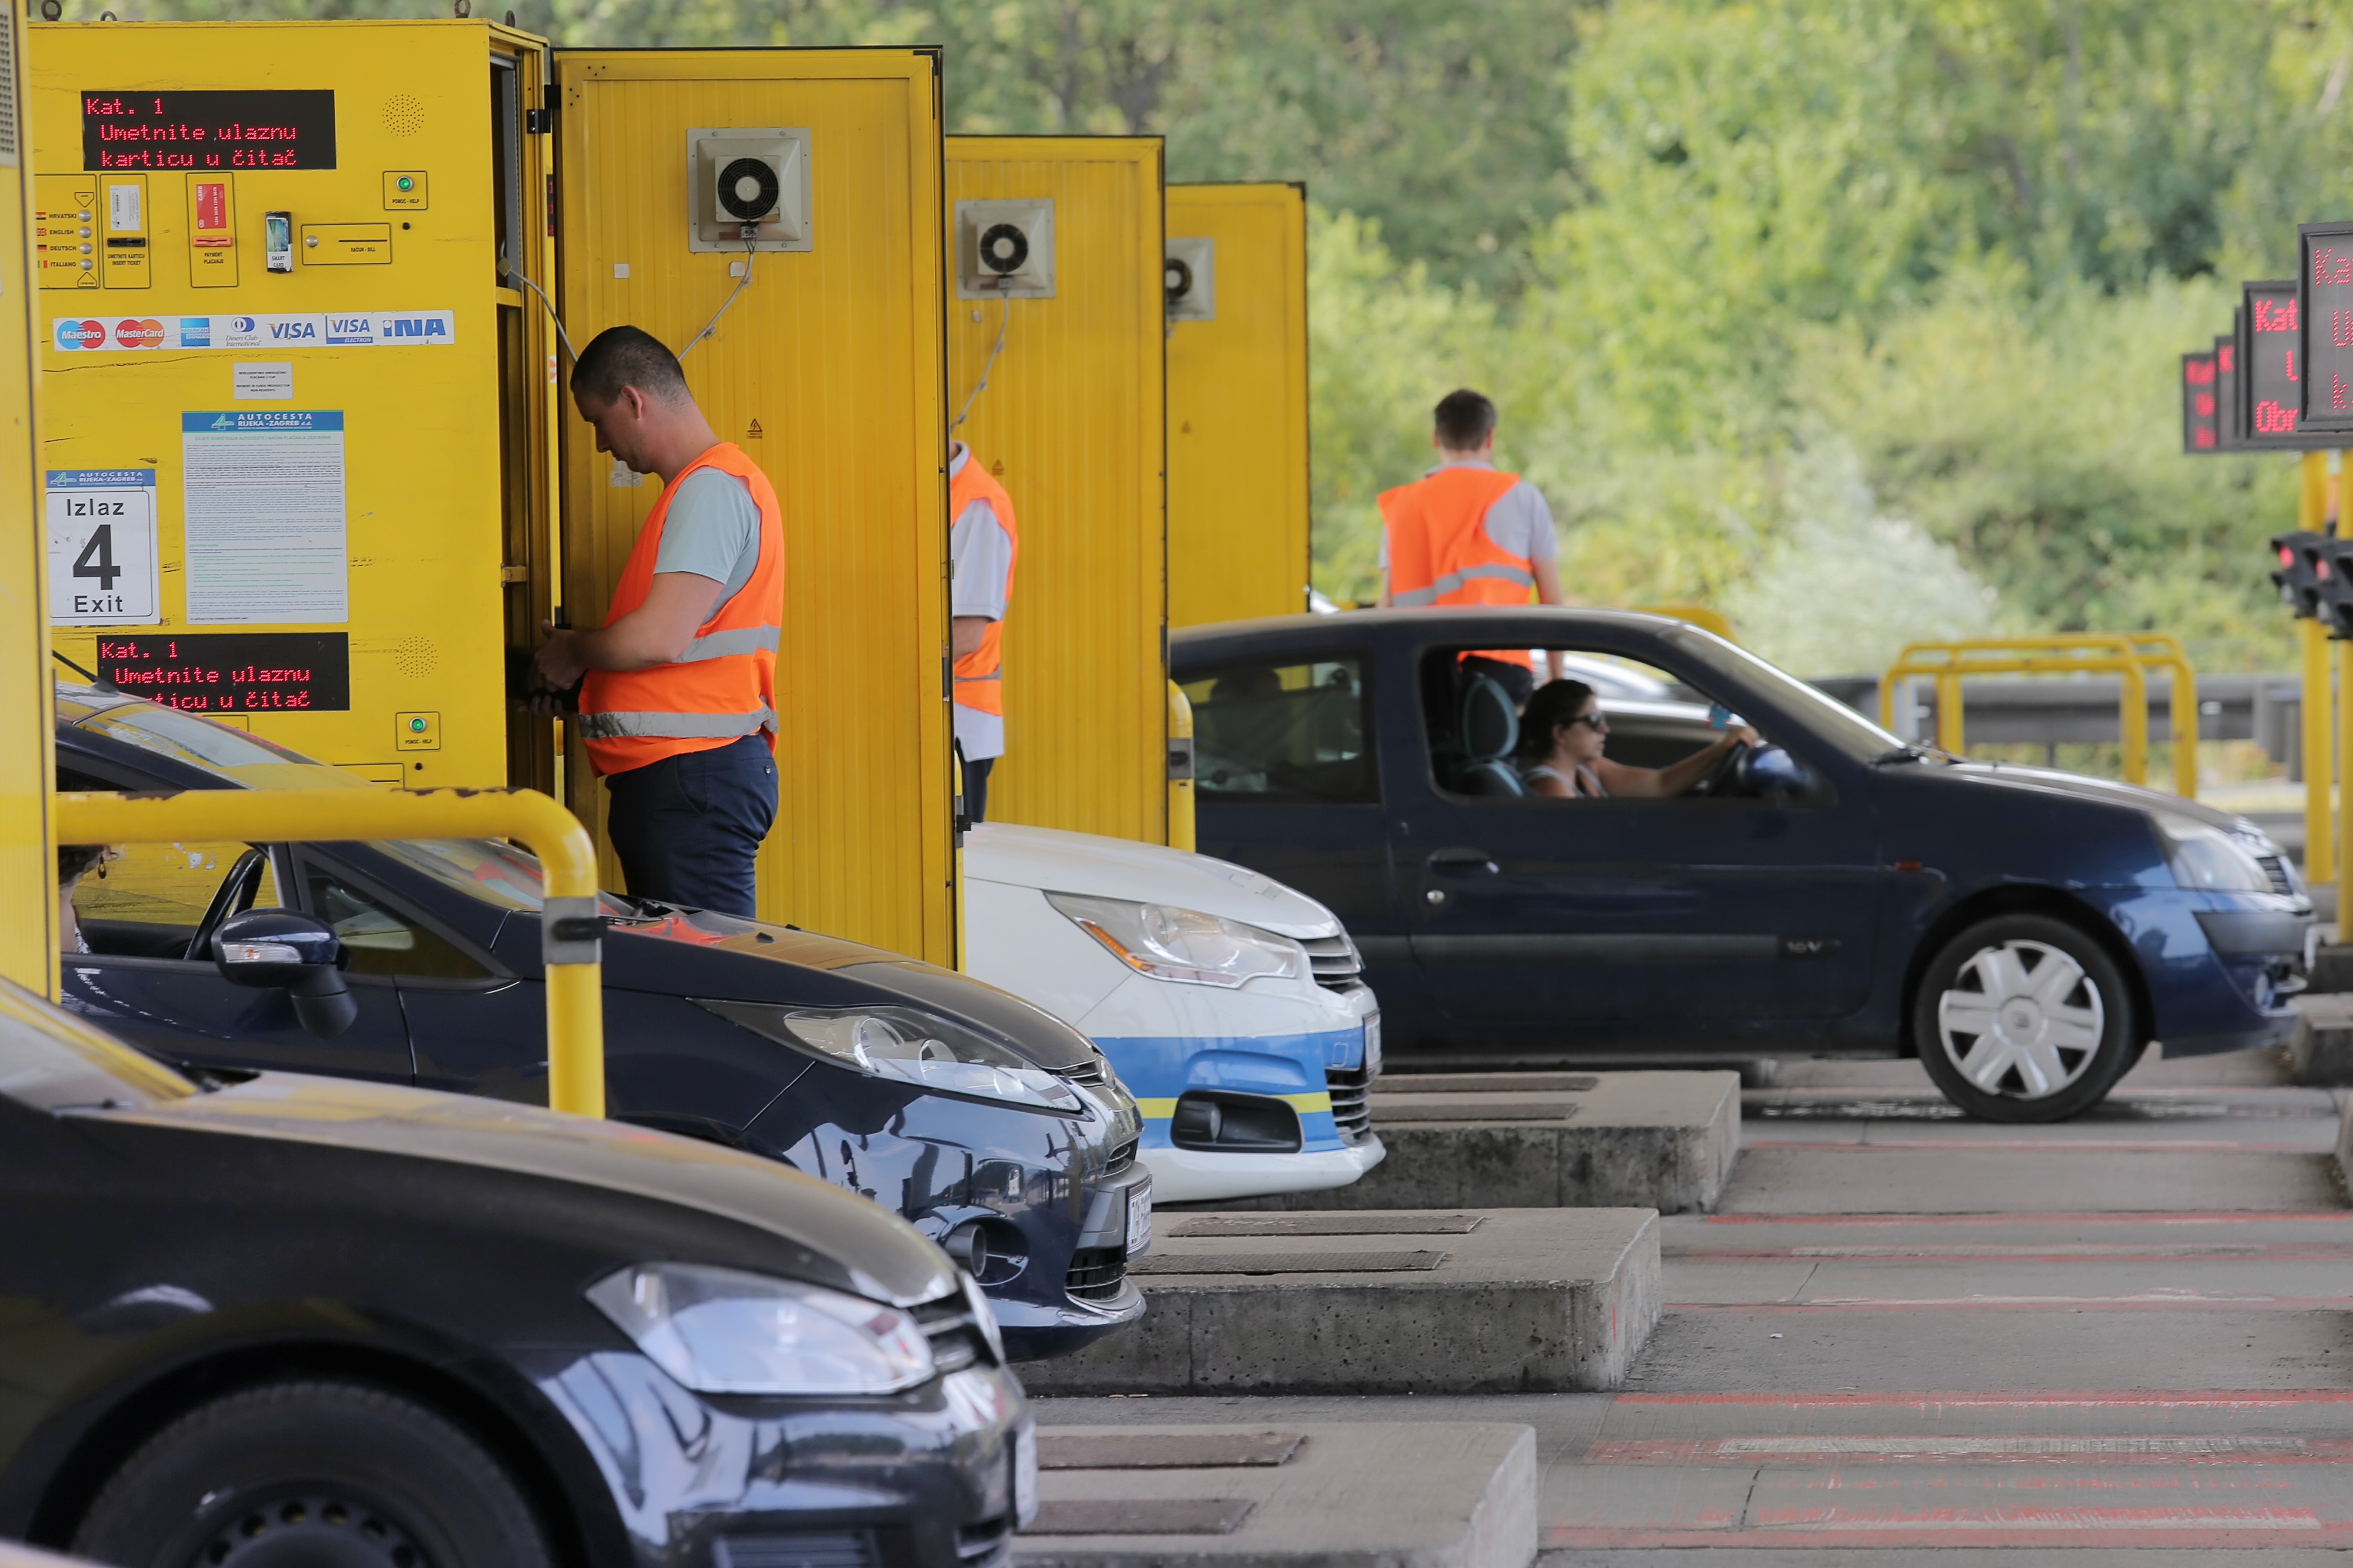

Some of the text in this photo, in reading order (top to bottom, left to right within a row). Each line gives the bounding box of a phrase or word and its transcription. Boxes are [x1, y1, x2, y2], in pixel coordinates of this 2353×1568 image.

[86, 98, 164, 115] Kat. 1
[101, 123, 297, 141] Umetnite ulaznu
[101, 149, 297, 166] karticu u čitač
[2315, 248, 2353, 285] Ka
[62, 330, 102, 339] Maestro
[116, 328, 164, 339] MasterCard
[268, 323, 316, 339] VISA
[330, 319, 370, 333] VISA
[66, 498, 124, 516] Izlaz
[73, 524, 121, 590] 4
[74, 595, 123, 612] Exit
[101, 641, 178, 659] Kat. 1
[115, 666, 311, 685] Umetnite ulaznu
[220, 696, 233, 709] u
[245, 690, 311, 708] čitač
